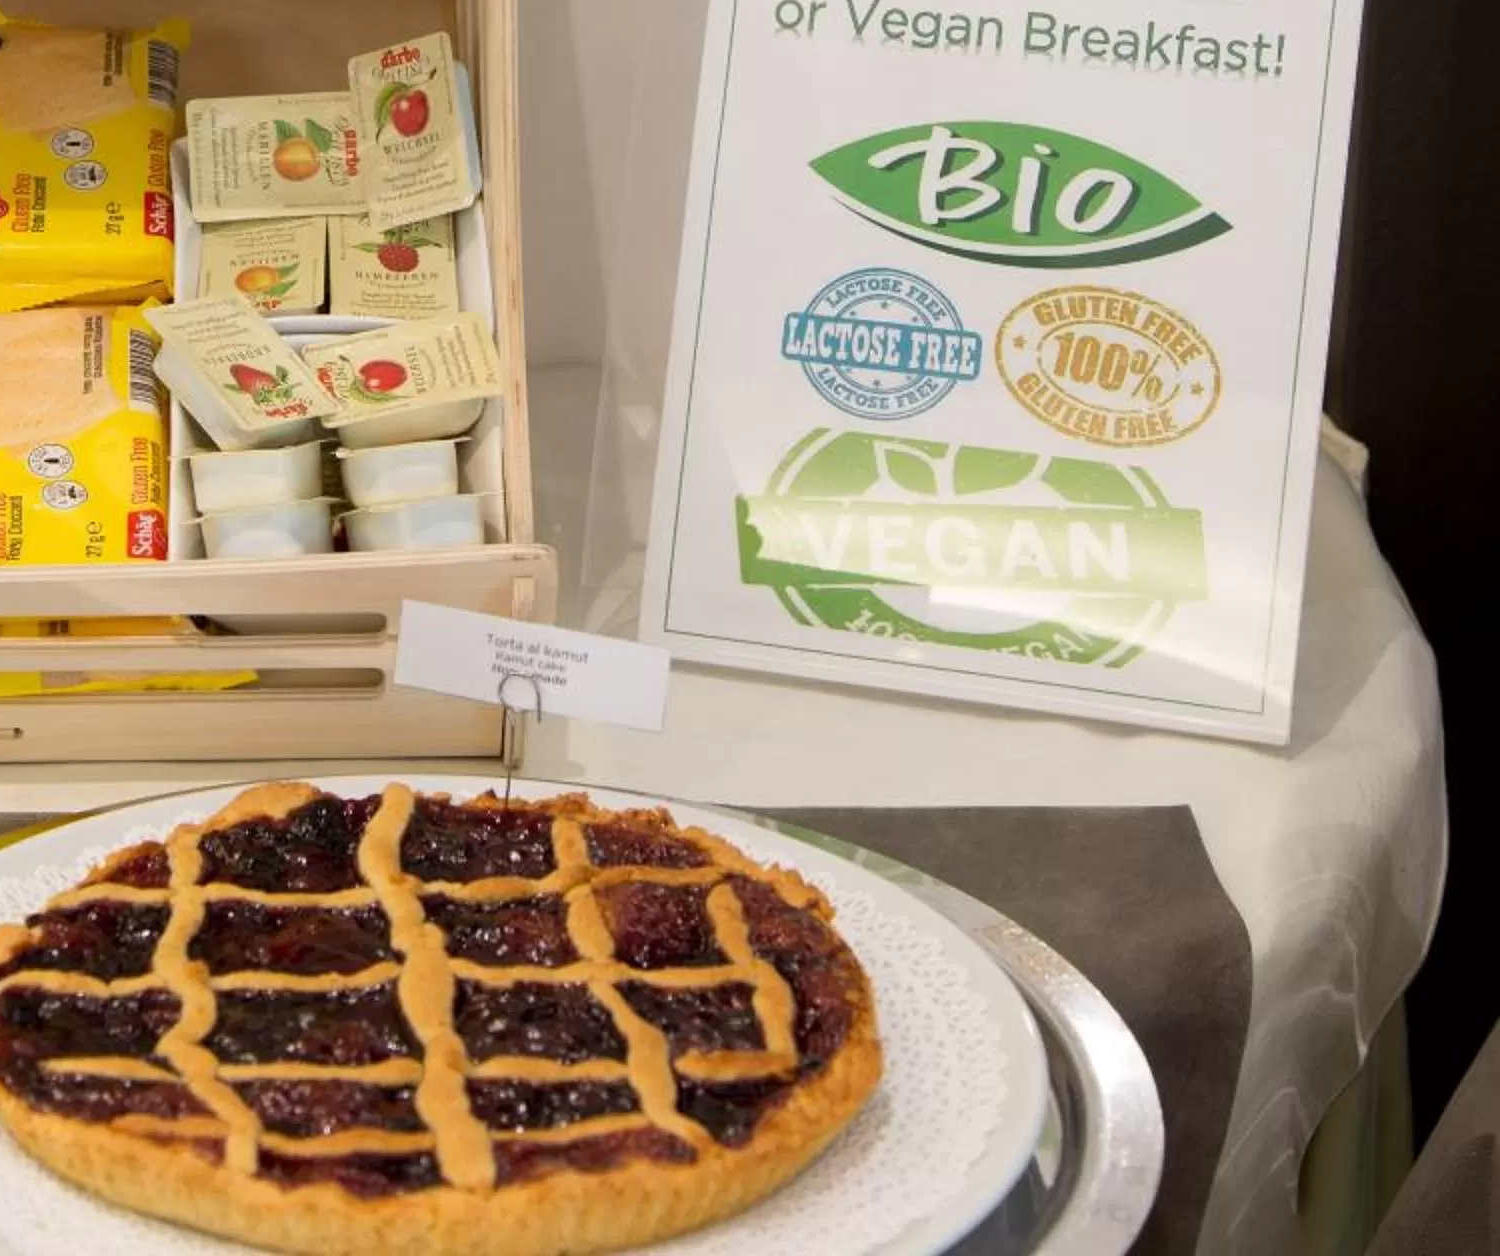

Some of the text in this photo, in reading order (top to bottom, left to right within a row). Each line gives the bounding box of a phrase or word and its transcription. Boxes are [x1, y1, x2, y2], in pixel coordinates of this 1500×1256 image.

[380, 46, 421, 71] darbo
[1023, 9, 1286, 76] Breakfast!
[867, 125, 1134, 233] Bio
[150, 195, 169, 234] Schär
[824, 277, 947, 321] LACTOSE FREE
[1032, 292, 1206, 366] GLUTEN FREE
[784, 315, 979, 376] LACTOSE FREE
[1052, 331, 1164, 404] 100%
[815, 366, 939, 411] LACTOSE FREE
[1016, 372, 1177, 441] GLUTEN FREE
[132, 513, 157, 556] Schär
[799, 512, 1132, 582] VEGAN
[544, 644, 589, 665] kamut
